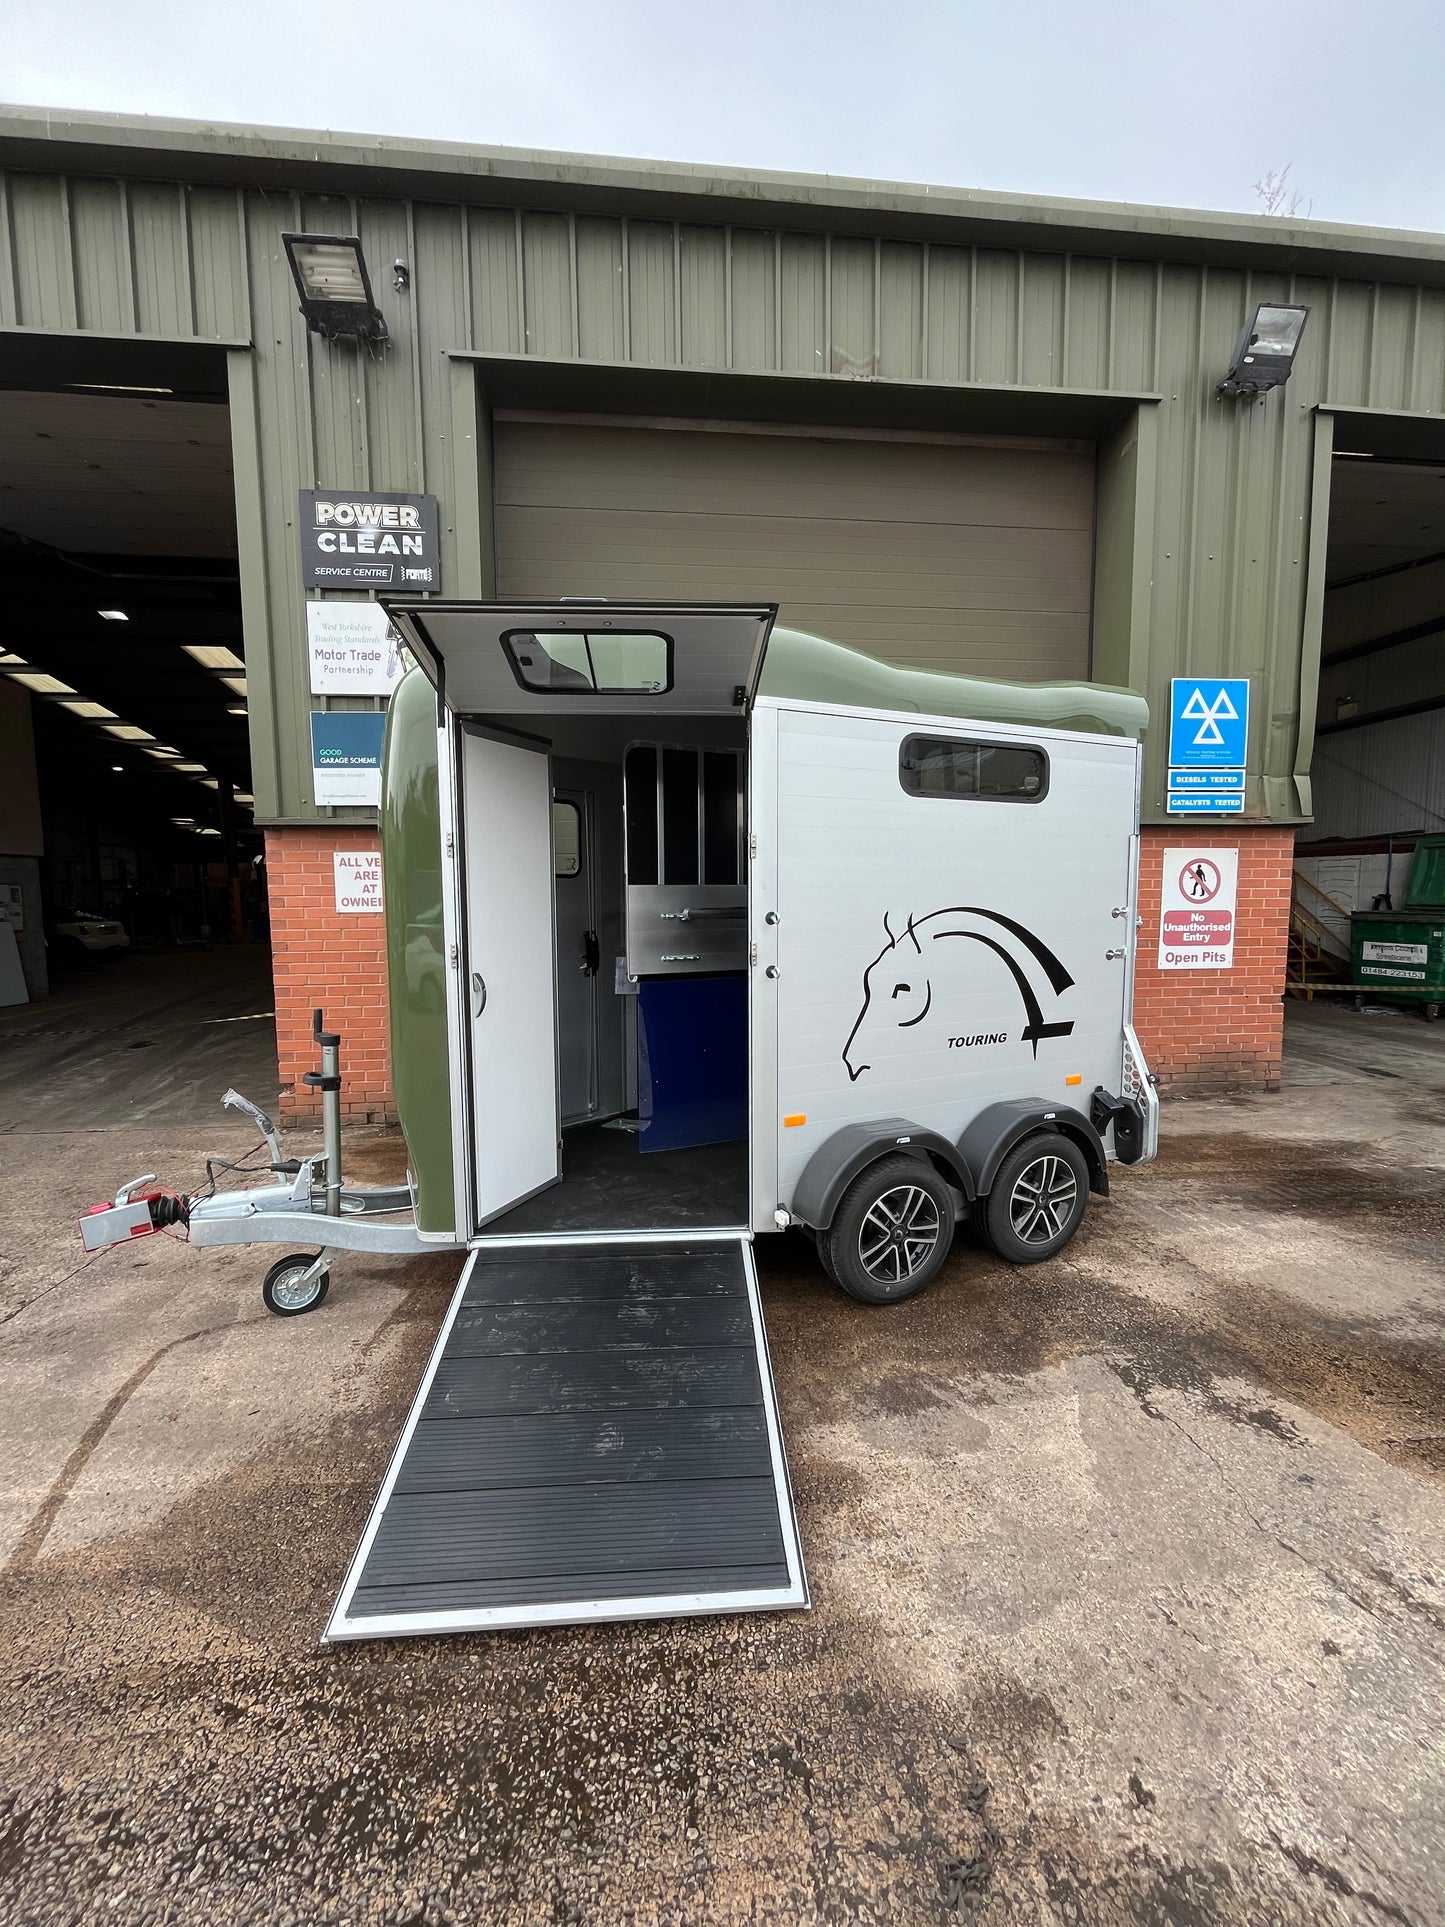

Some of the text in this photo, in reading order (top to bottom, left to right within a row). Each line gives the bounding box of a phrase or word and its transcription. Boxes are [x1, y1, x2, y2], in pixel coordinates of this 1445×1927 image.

[316, 502, 421, 528] POWER
[317, 533, 423, 555] CLEAN
[314, 567, 388, 577] SERVICE CENTRE
[322, 623, 372, 632] West Yorkshire
[314, 635, 380, 644] Trading Standards
[315, 649, 381, 661] Motor Trade
[324, 665, 374, 676] Partnership
[339, 857, 362, 867] ALL
[354, 871, 379, 880] ARE
[362, 884, 378, 894] AT
[1191, 913, 1205, 922] No
[1164, 923, 1231, 932] Unauthorised
[1183, 933, 1211, 943] Entry
[1165, 952, 1226, 965] Open Pits
[948, 1032, 1008, 1049] TOURING
